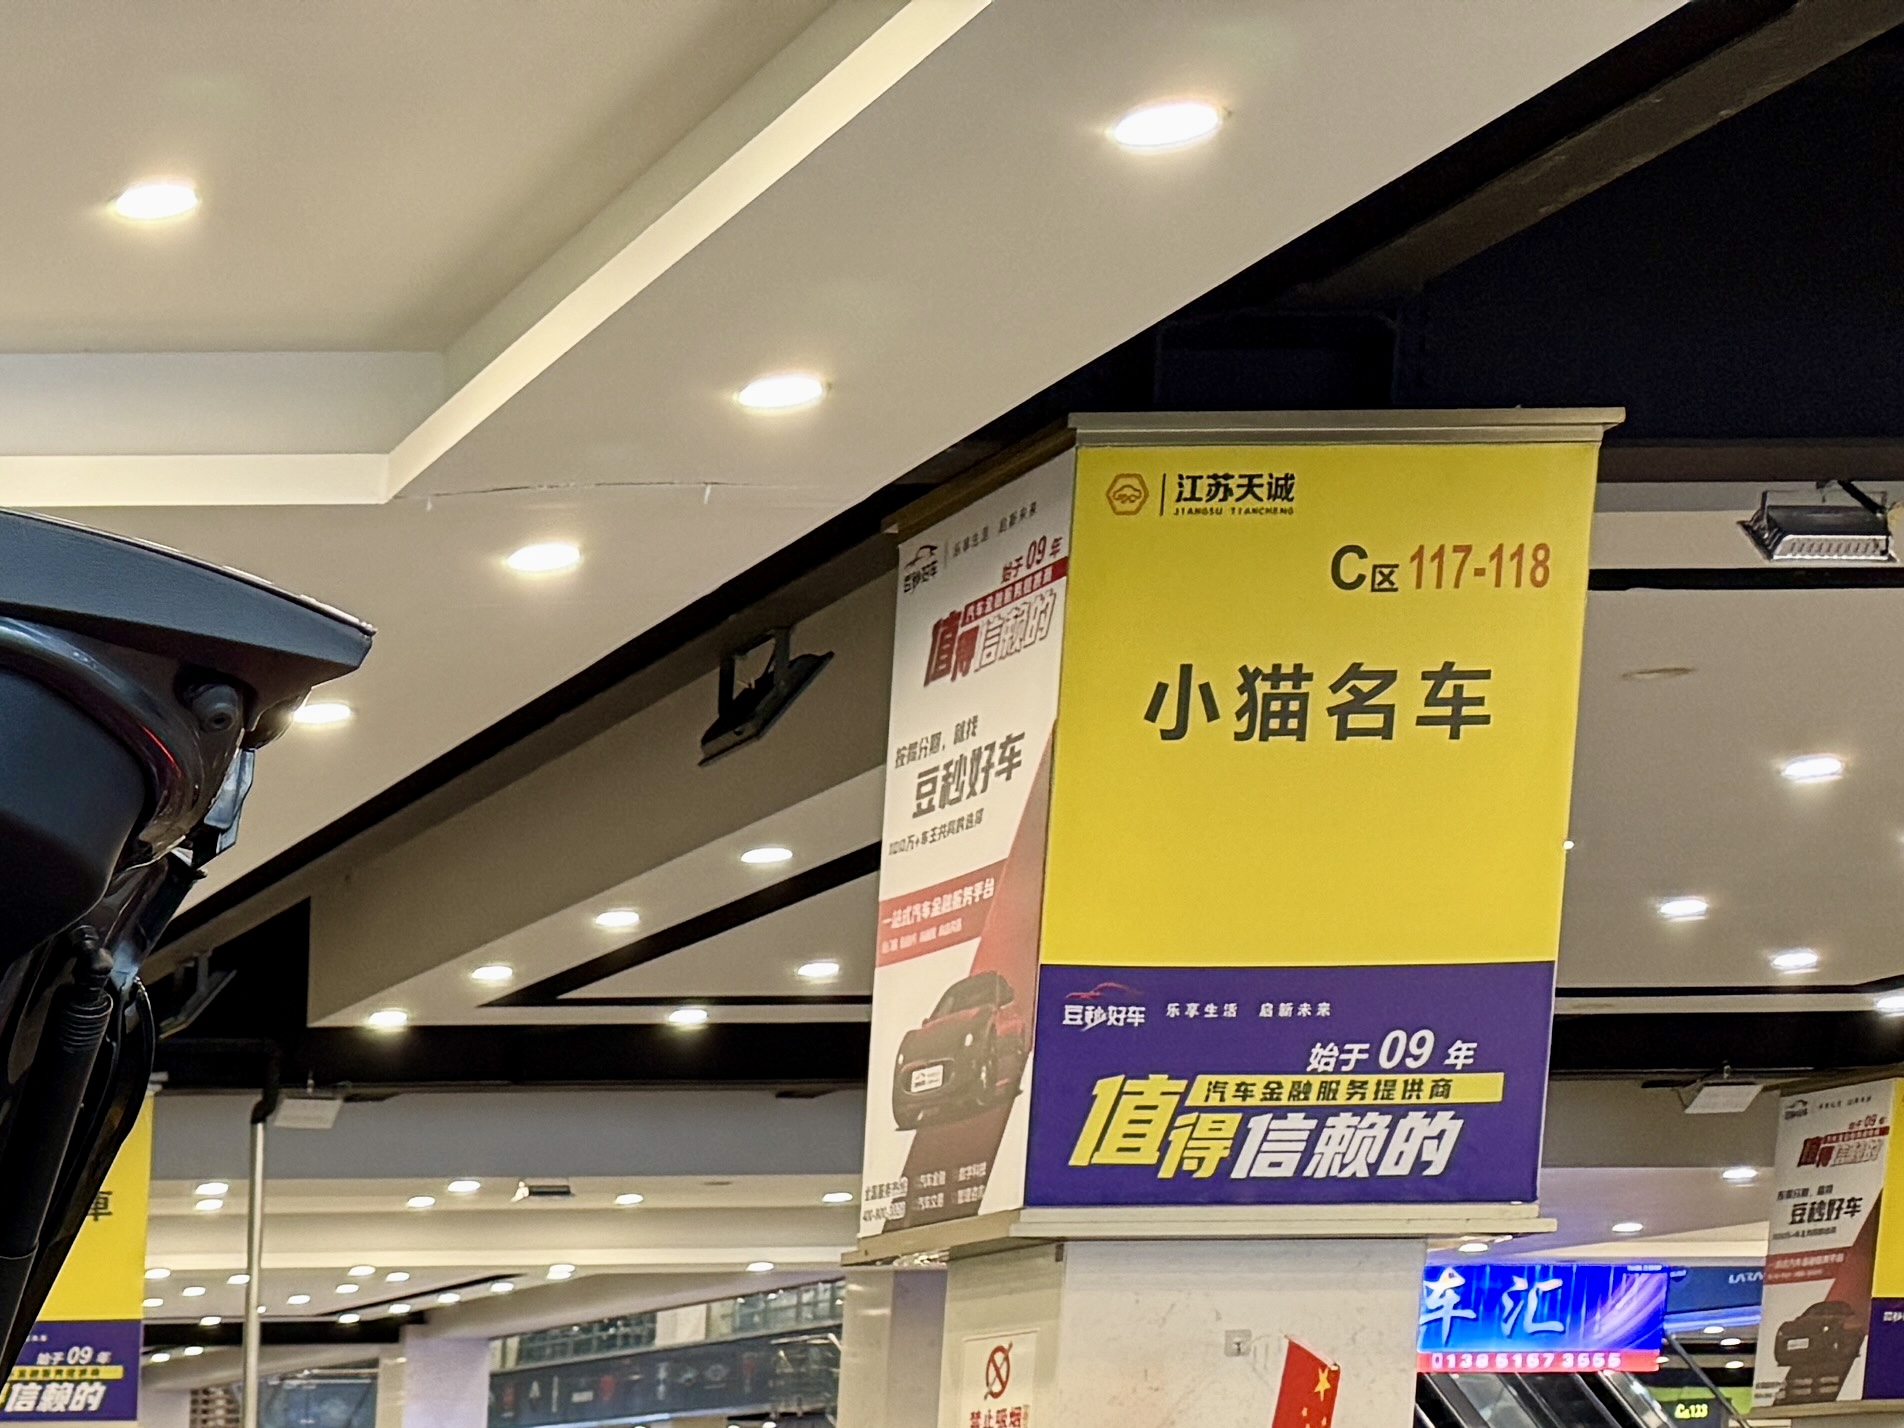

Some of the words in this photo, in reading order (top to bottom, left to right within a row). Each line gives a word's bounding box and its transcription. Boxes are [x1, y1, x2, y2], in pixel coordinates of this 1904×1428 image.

[1175, 472, 1296, 504] 江苏天诚
[1173, 507, 1223, 516] JIANGSU
[1143, 661, 1492, 742] 小猫名车
[912, 732, 1025, 818] 豆秒好车
[1063, 1004, 1146, 1031] 豆秒好车
[1165, 1002, 1239, 1018] 乐享生活
[1306, 1028, 1478, 1073] 始于09年
[1204, 1078, 1453, 1103] 汽车金融服务提供商
[1068, 1074, 1464, 1180] 值得信赖的
[1789, 1197, 1863, 1225] 豆秒好车
